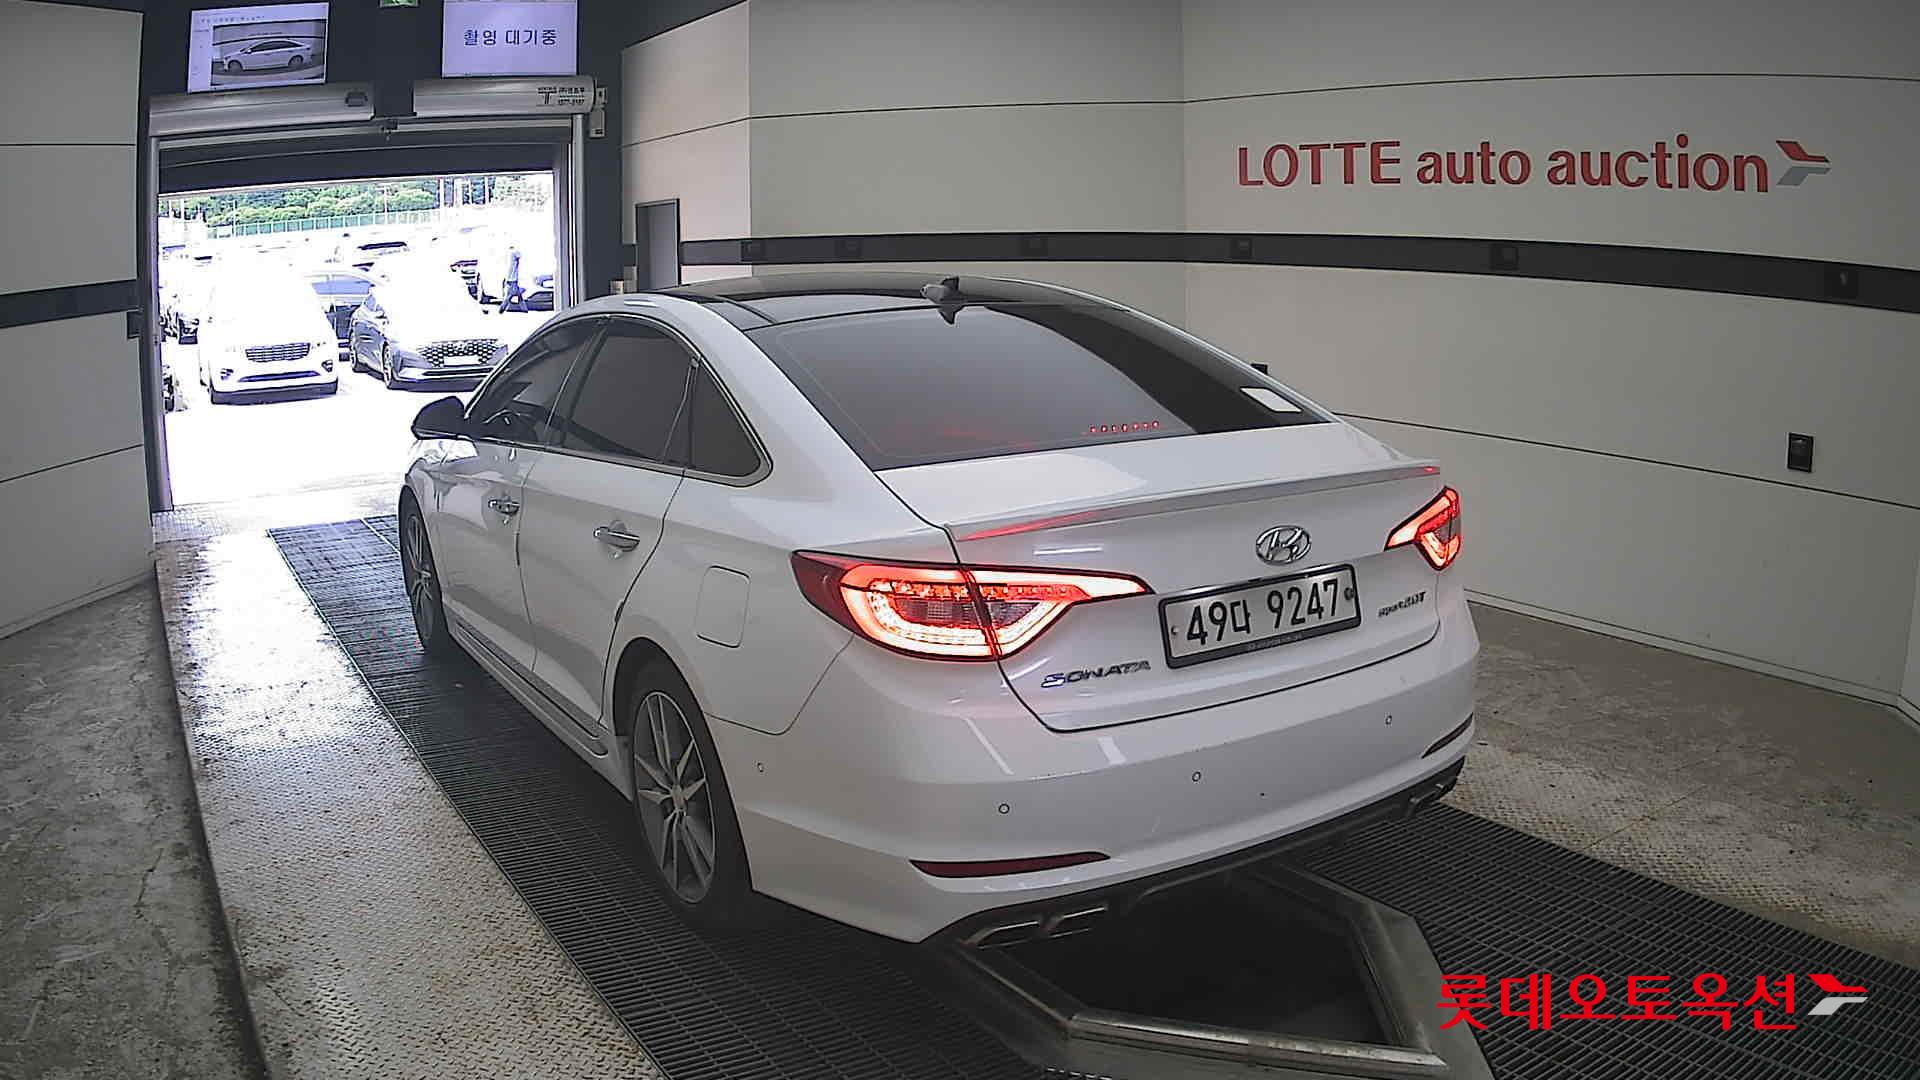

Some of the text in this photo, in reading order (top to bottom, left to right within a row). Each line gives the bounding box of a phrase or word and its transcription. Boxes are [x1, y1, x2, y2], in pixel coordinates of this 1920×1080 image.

[505, 29, 557, 46] 대기중
[1238, 133, 1769, 193] LOTTE auto auction
[1186, 578, 1339, 646] 49다 9247
[1040, 660, 1152, 688] SONATA
